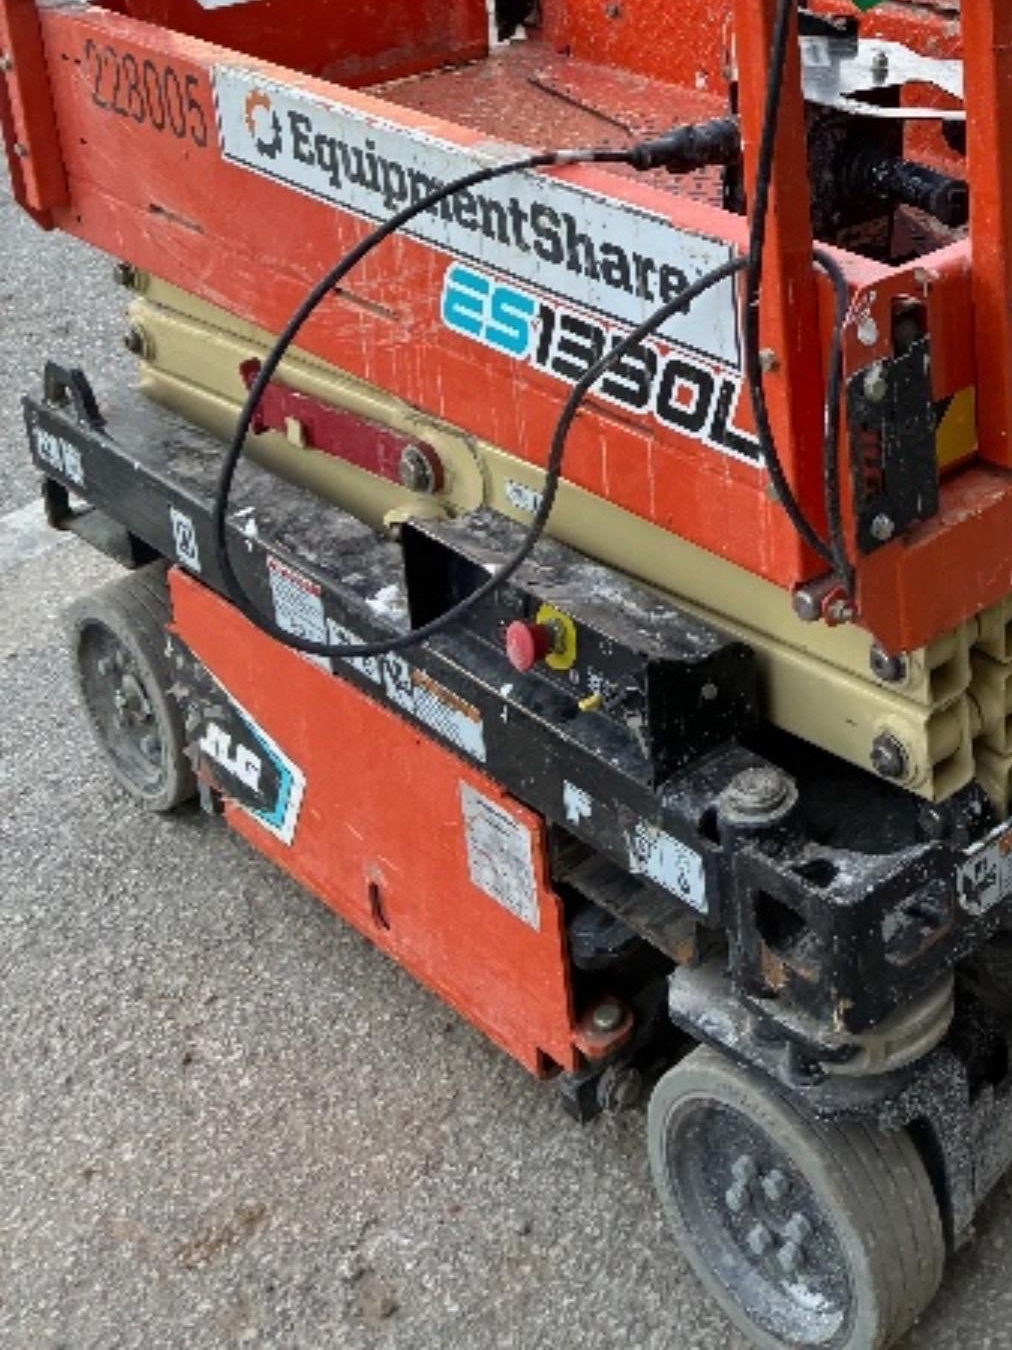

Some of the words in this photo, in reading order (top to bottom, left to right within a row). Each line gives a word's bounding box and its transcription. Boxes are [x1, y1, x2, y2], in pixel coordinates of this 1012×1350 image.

[287, 110, 692, 306] EquipmentShare
[442, 262, 766, 465] ES1330L
[200, 722, 262, 792] JLG
